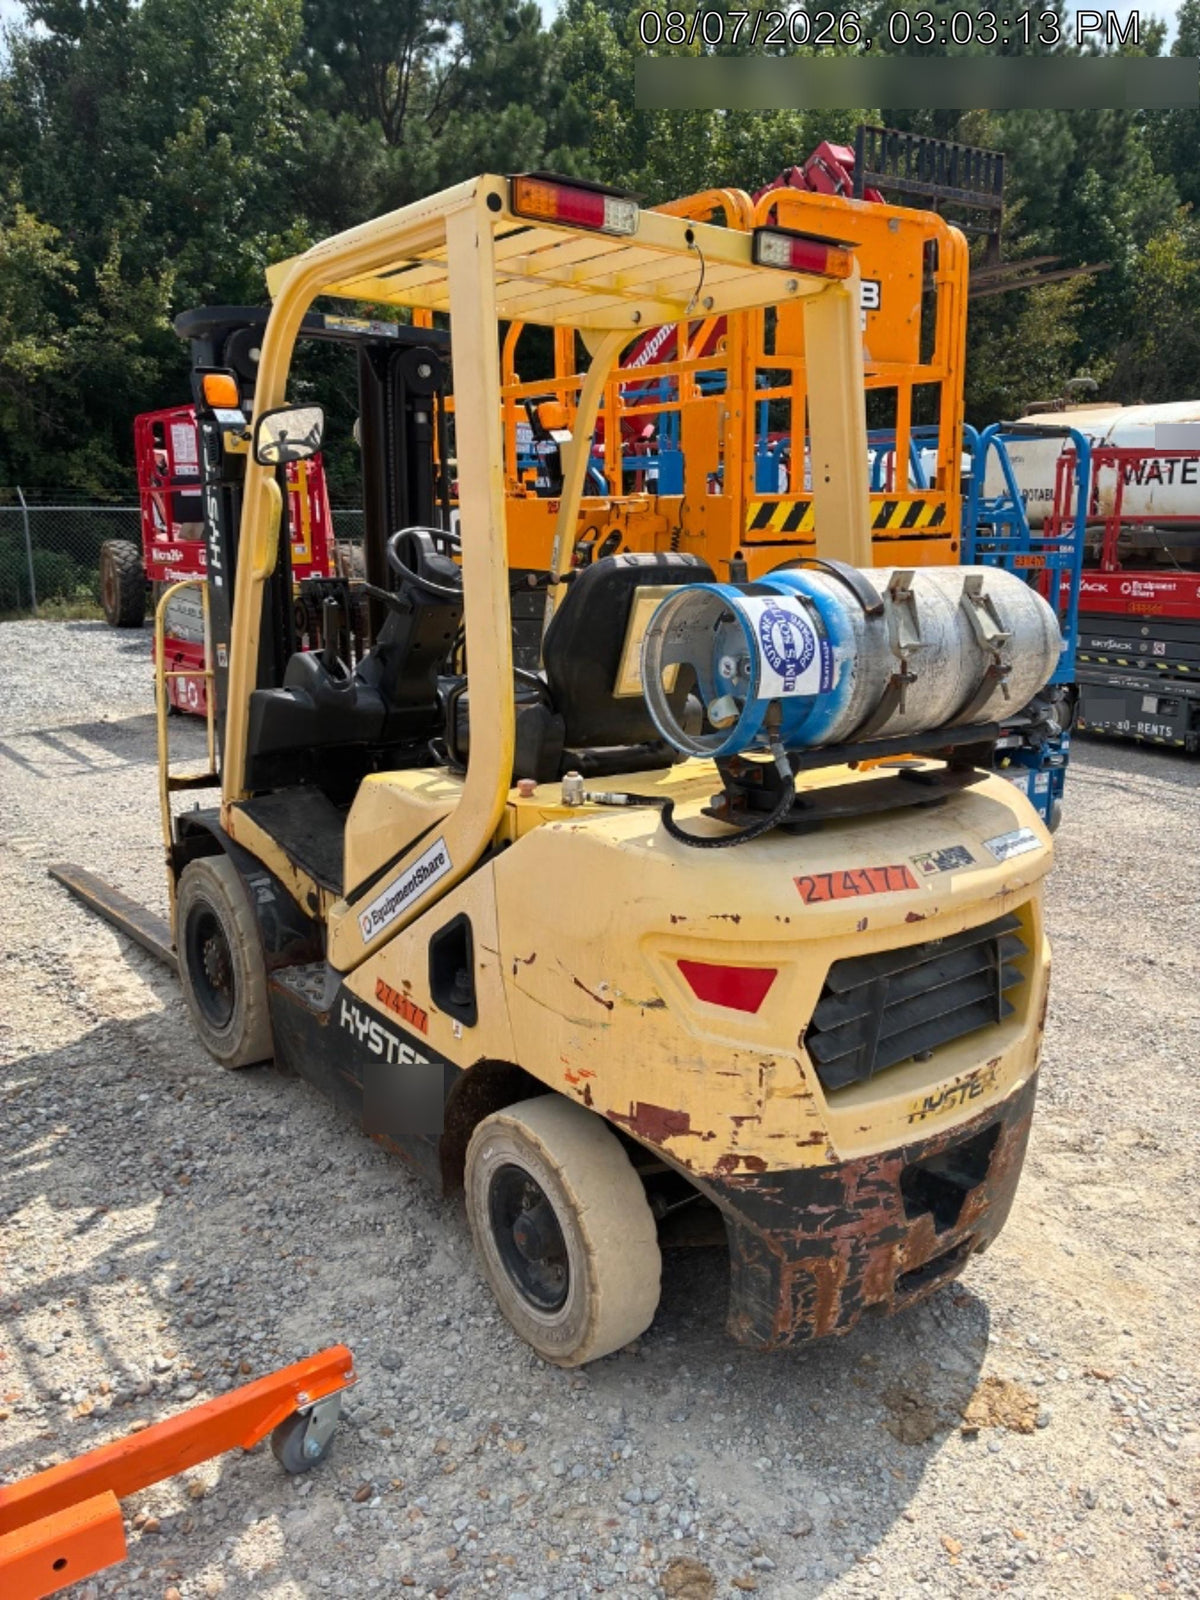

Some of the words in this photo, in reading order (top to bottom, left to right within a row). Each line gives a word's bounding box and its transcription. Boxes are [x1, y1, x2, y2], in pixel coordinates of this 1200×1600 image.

[371, 851, 445, 926] EquipmentShare
[799, 866, 914, 904] 274177
[375, 978, 428, 1034] 274177
